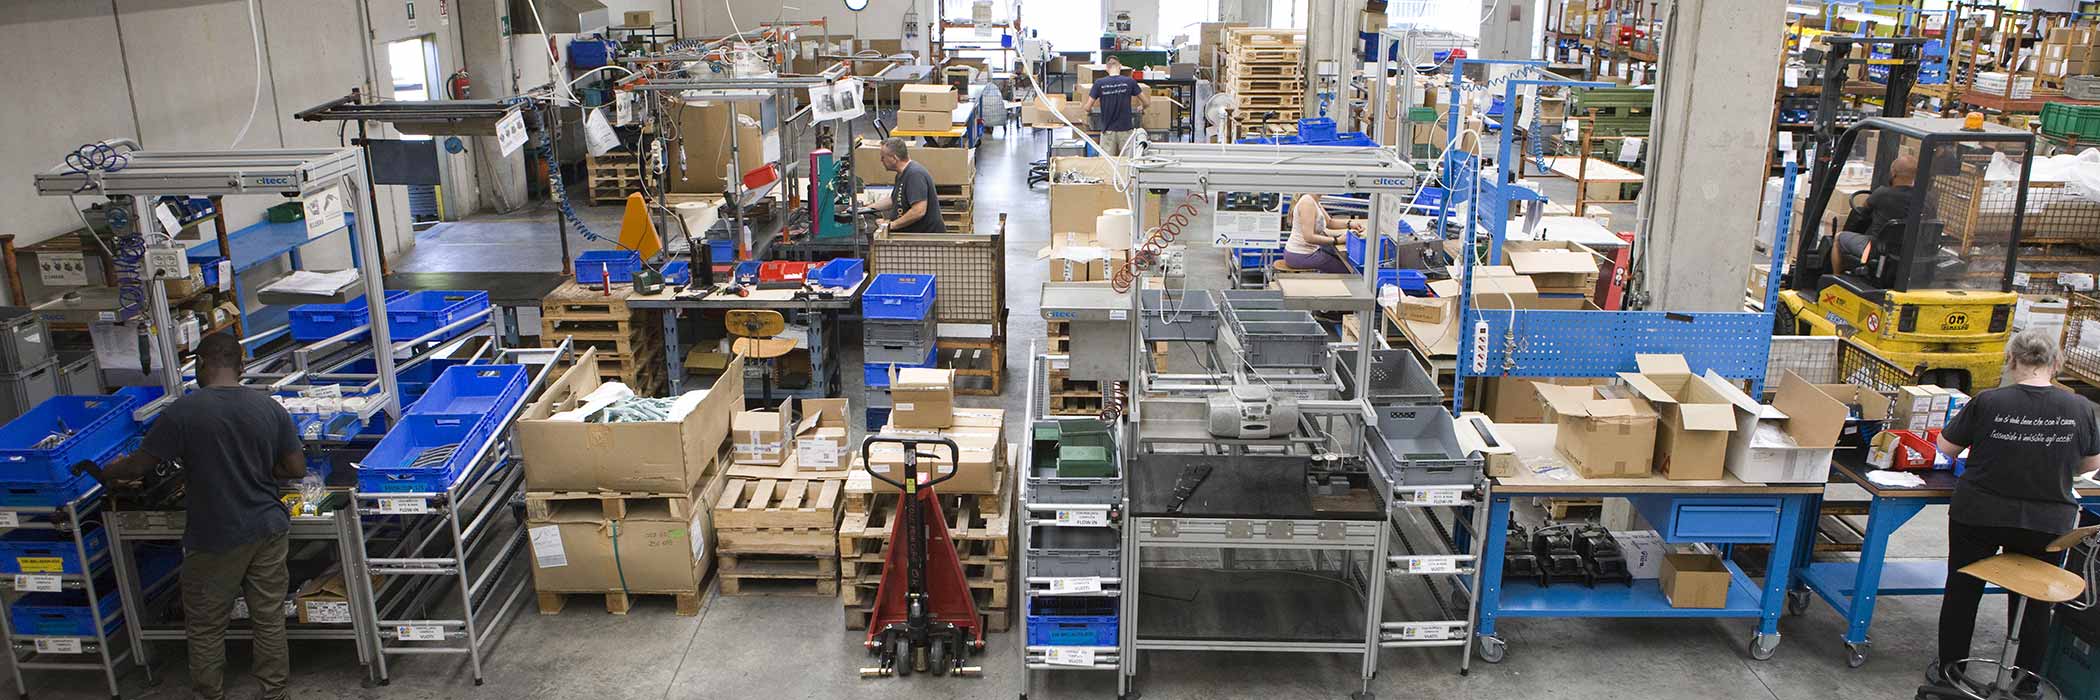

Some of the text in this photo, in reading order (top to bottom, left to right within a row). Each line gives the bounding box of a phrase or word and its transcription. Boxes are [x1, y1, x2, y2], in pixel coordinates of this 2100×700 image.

[1373, 178, 1406, 186] eltecc
[1949, 315, 1965, 325] OM
[2020, 416, 2033, 425] bene
[2033, 417, 2043, 426] che
[2044, 418, 2055, 426] con
